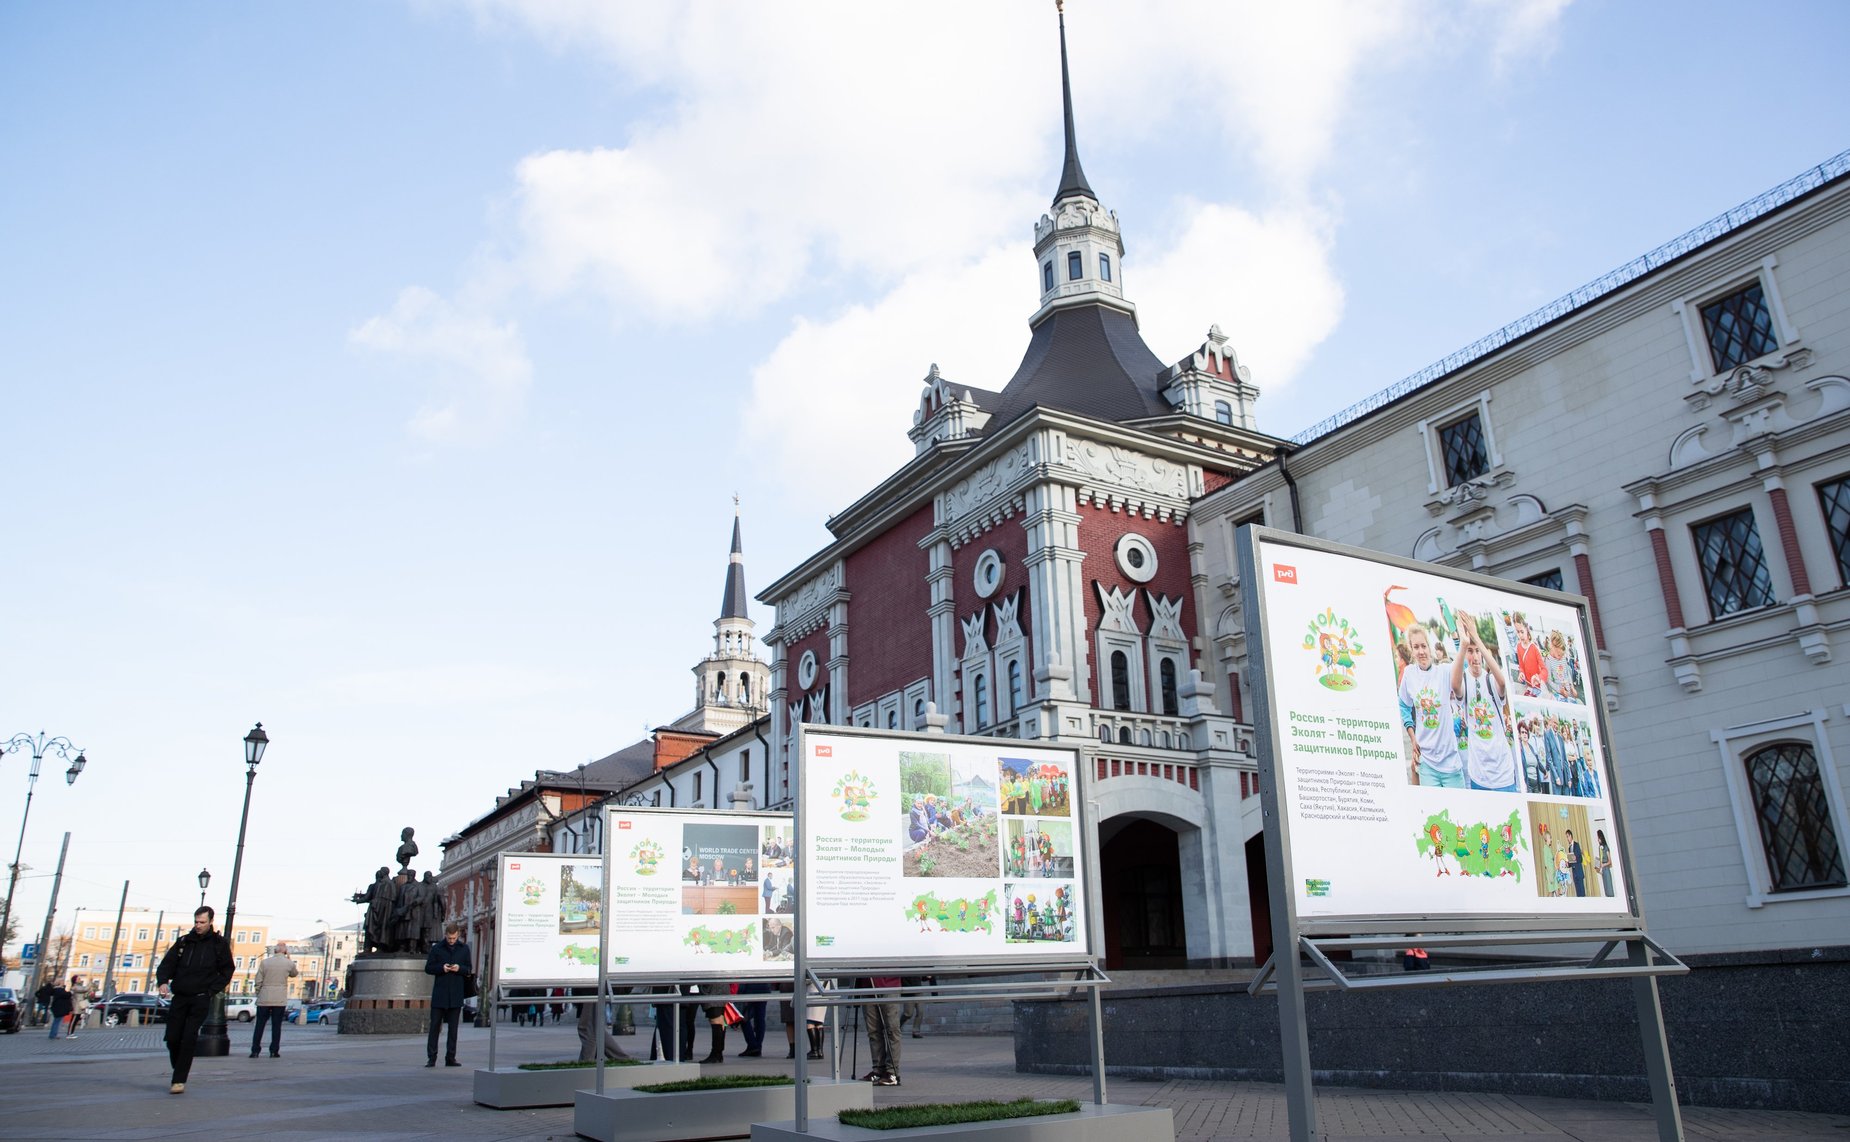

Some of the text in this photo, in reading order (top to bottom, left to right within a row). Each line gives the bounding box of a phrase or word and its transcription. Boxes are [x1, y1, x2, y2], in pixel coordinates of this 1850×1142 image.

[1289, 711, 1325, 724] Россия
[1336, 717, 1390, 730] территория
[1291, 726, 1326, 738] Эколят
[1337, 730, 1382, 744] Молодых
[1293, 744, 1398, 760] защитников Природы
[1296, 767, 1334, 776] Территориями
[1301, 812, 1341, 820] Краснодарский
[816, 835, 842, 843] Россия
[851, 837, 893, 845] территория
[816, 854, 897, 863] защитников Природы
